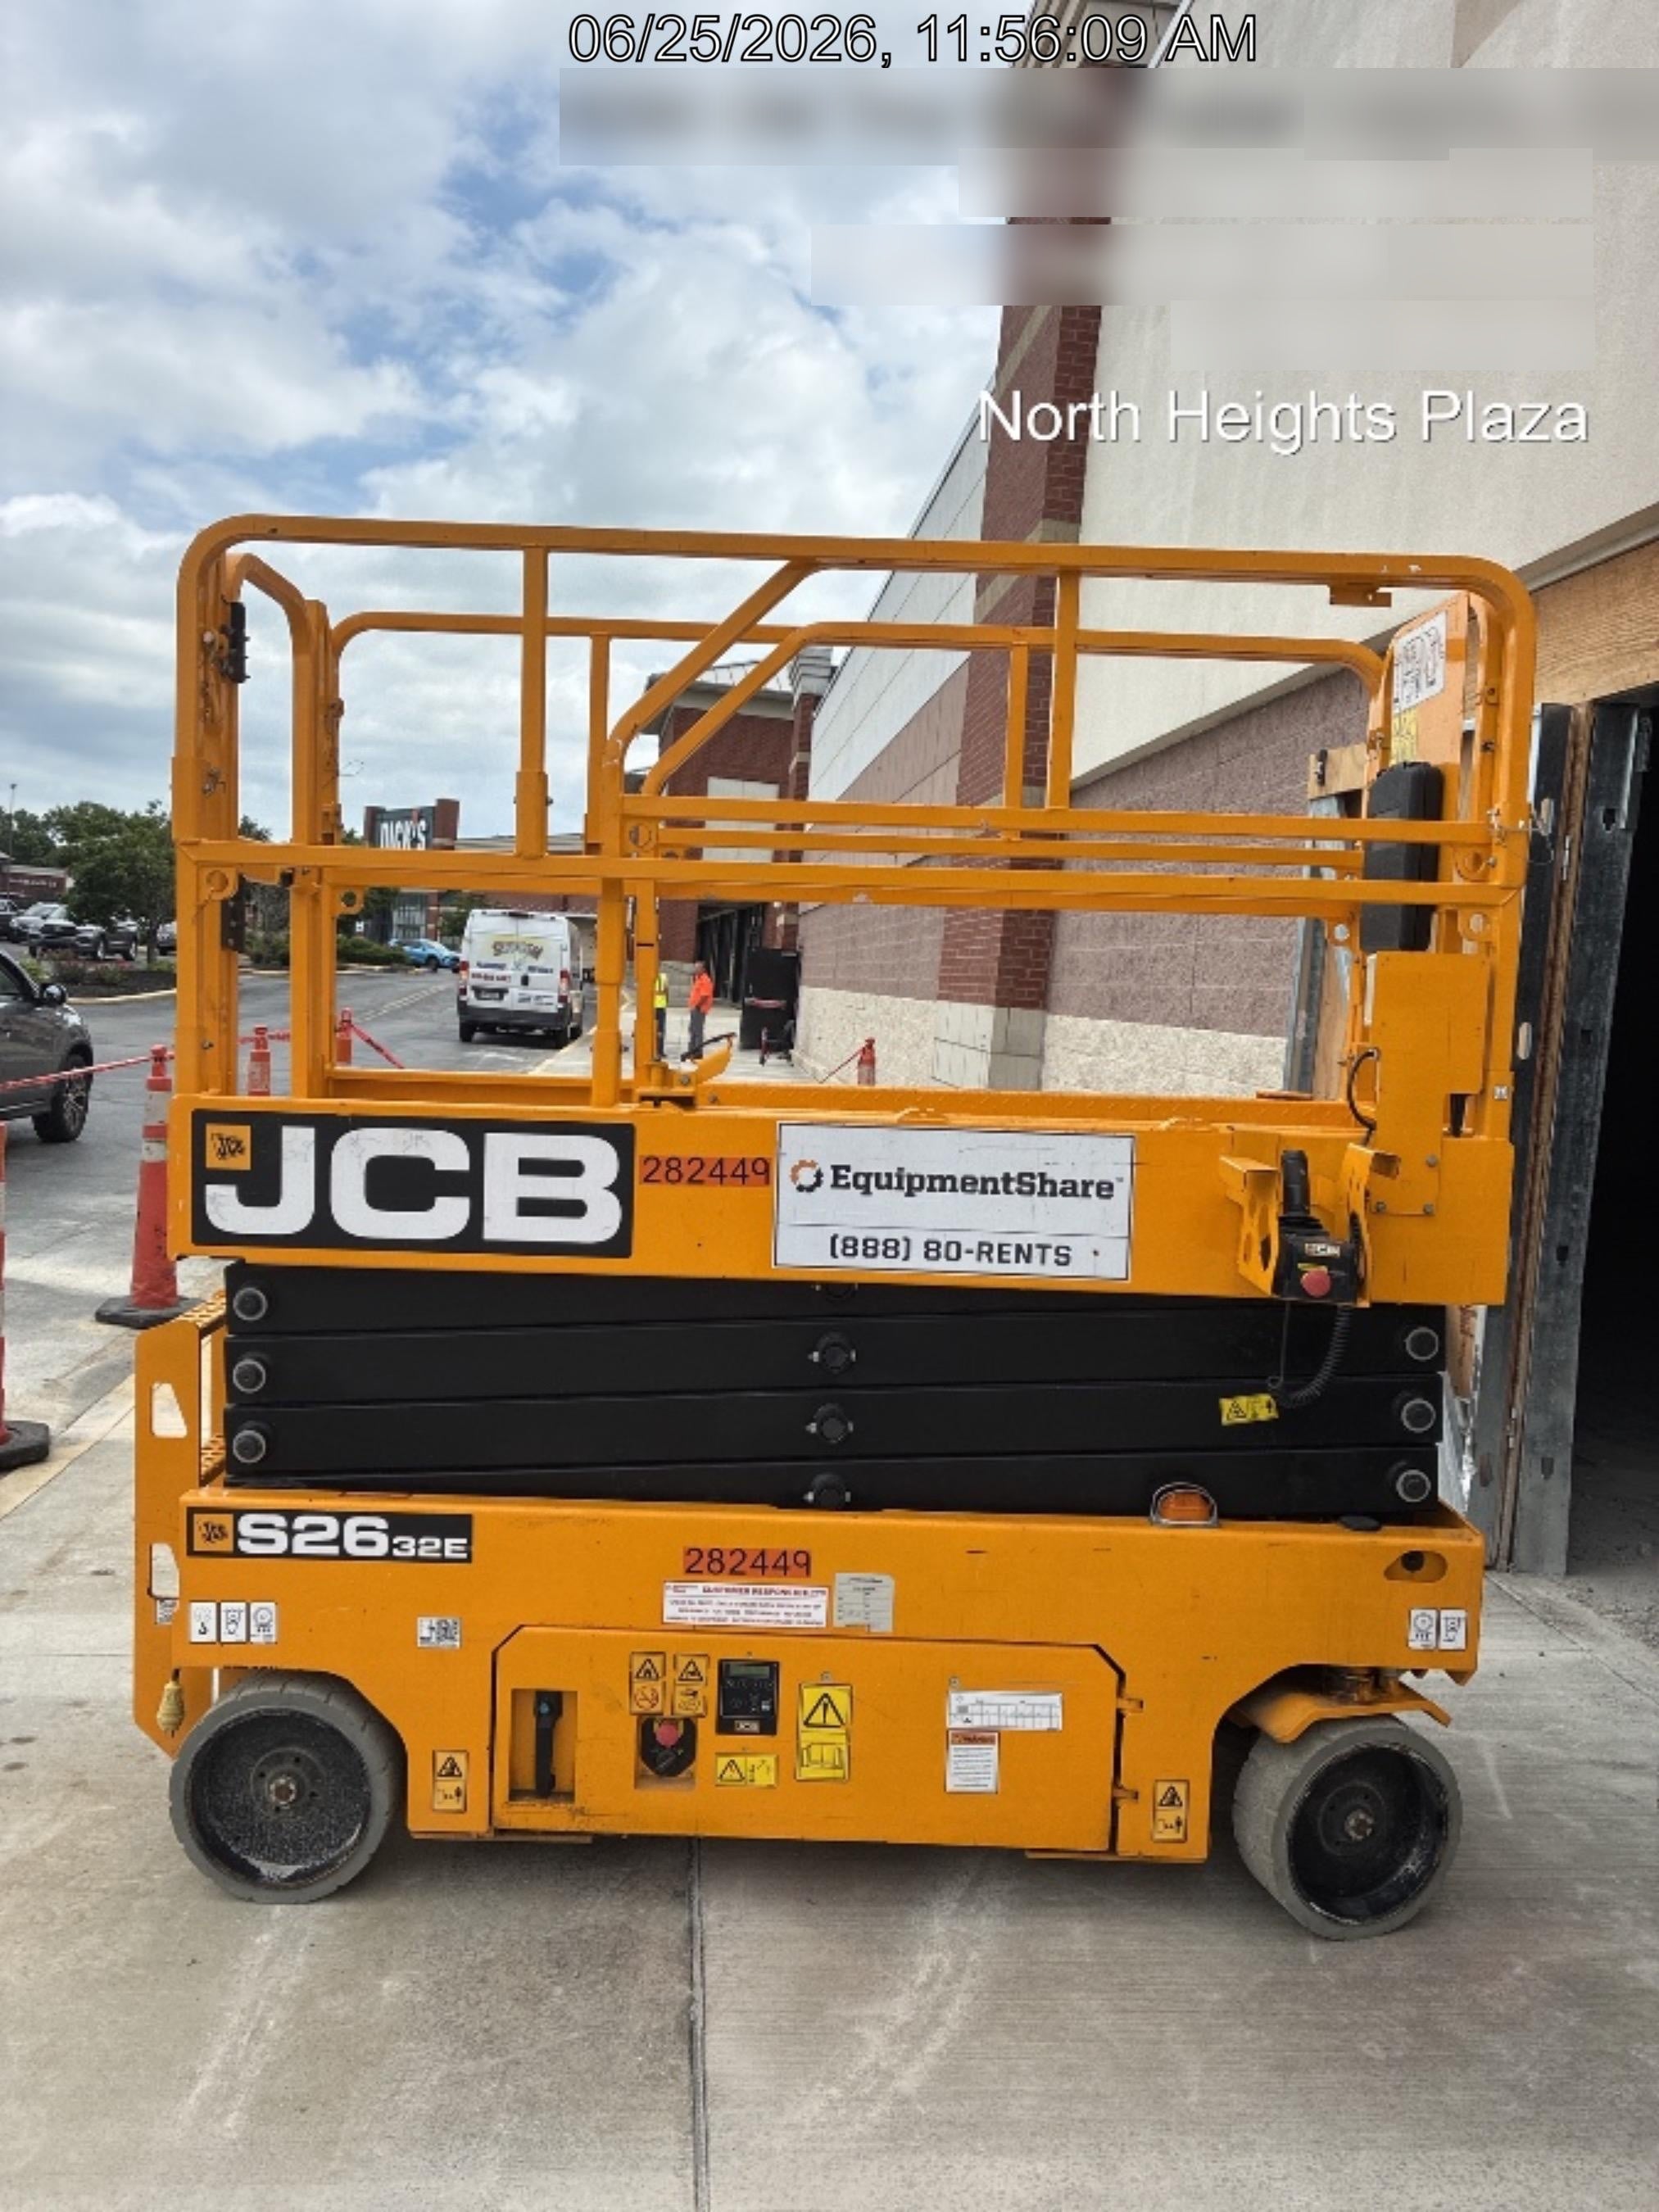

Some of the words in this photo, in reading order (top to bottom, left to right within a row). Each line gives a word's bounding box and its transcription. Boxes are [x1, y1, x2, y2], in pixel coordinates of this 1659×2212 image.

[205, 1125, 623, 1244] JCB
[642, 1156, 770, 1185] 282449
[830, 1163, 1116, 1200] EquipmentShare
[829, 1233, 912, 1262] (888)
[922, 1240, 1072, 1267] 80-RENTS
[684, 1547, 811, 1577] 282449
